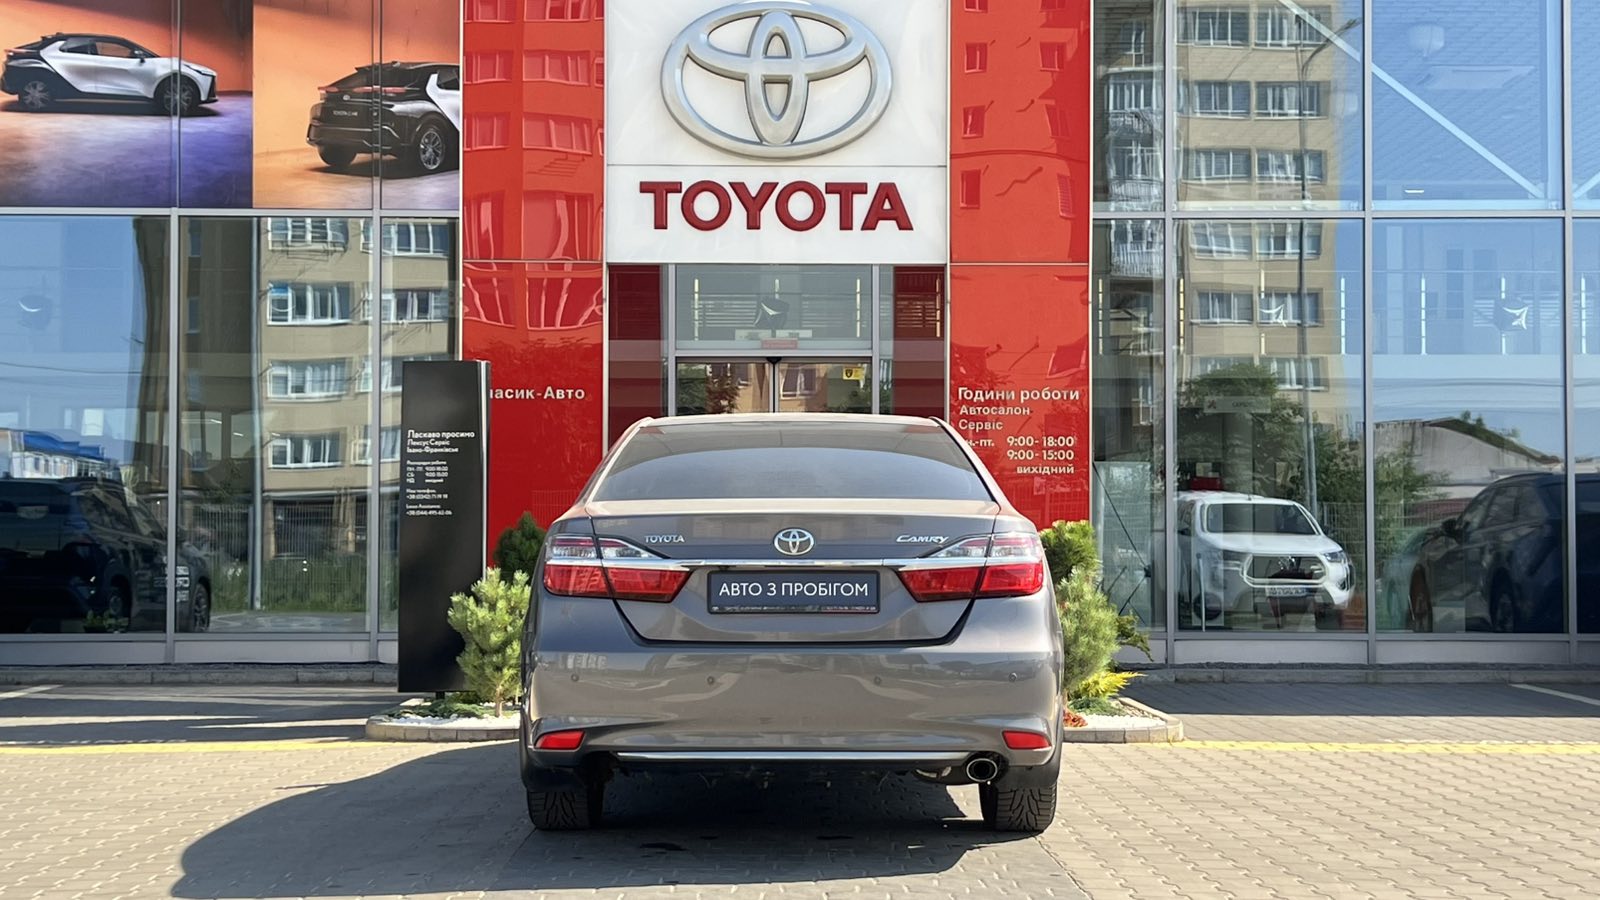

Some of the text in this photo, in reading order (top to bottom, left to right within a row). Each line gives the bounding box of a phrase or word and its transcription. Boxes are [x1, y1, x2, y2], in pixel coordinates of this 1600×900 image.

[639, 180, 914, 232] TOYOTA
[958, 387, 1079, 403] Години роботи
[959, 404, 1030, 416] Автосалон
[958, 419, 1004, 432] Сервіс
[1016, 464, 1075, 476] вихідний
[644, 534, 685, 543] TOYOTA
[719, 583, 868, 597] АВТО З ПРОБІГОМ
